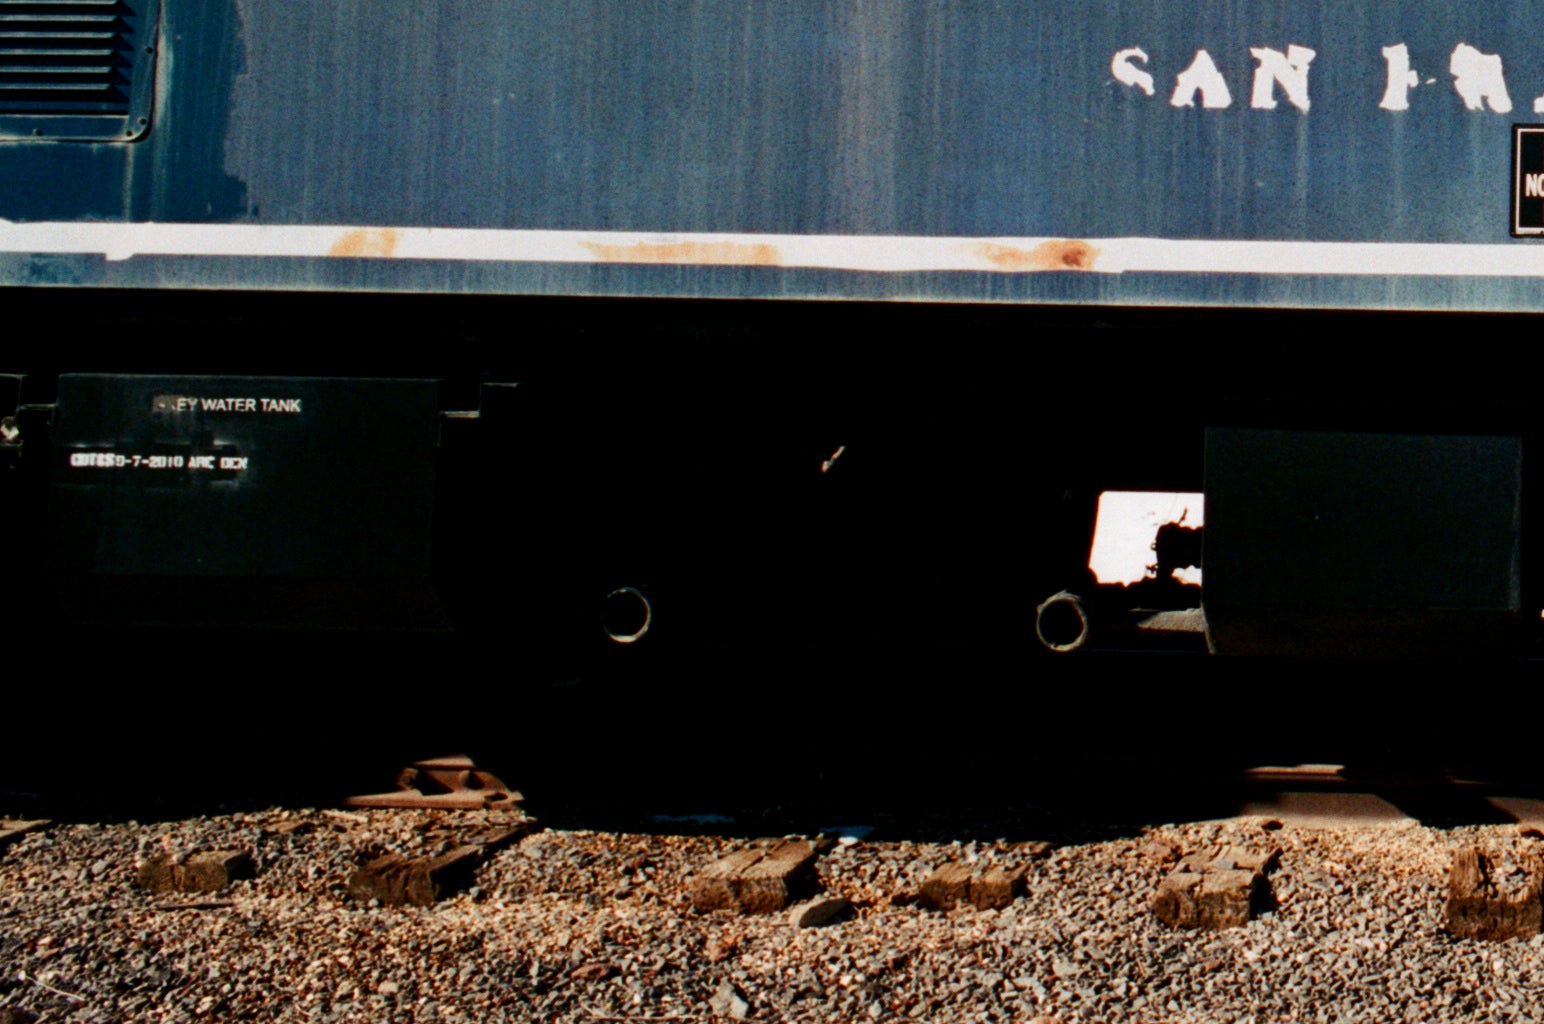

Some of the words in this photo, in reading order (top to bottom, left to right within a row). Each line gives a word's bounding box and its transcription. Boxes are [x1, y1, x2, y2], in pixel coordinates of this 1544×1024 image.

[1111, 44, 1317, 115] SAN
[201, 397, 256, 413] WATER
[260, 397, 301, 414] TANK
